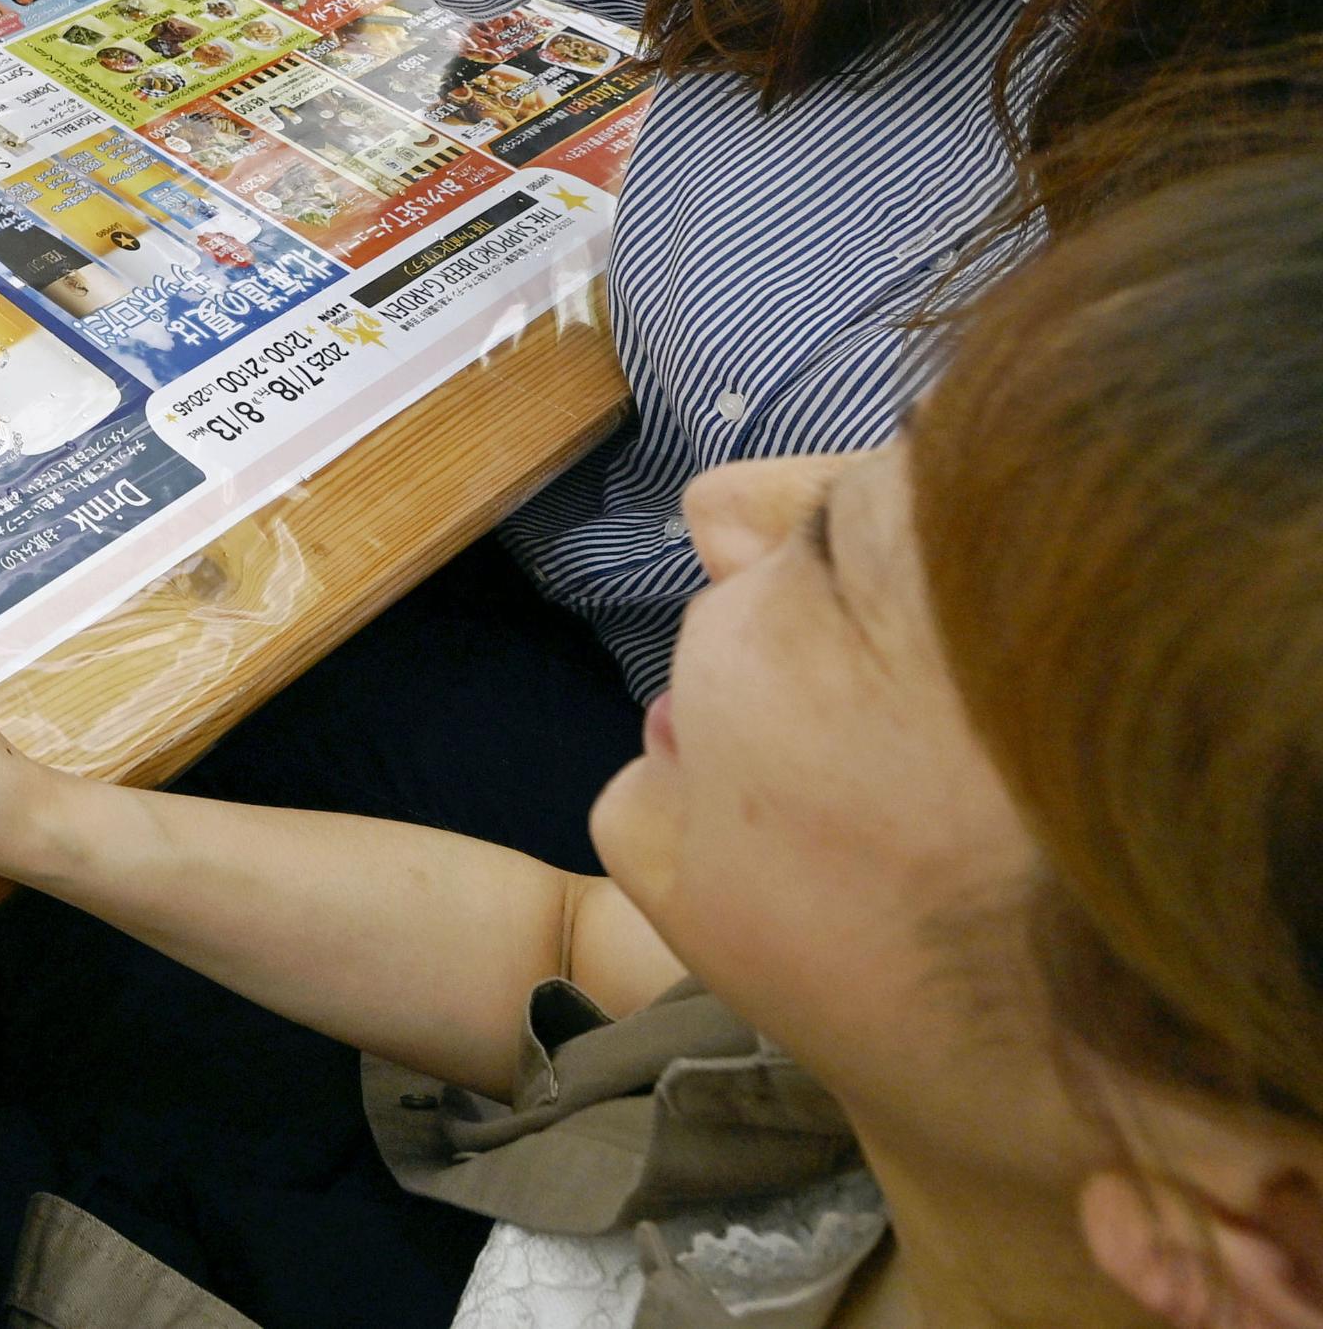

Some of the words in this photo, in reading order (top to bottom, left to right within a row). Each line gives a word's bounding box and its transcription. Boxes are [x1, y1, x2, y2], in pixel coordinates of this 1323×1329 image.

[468, 218, 495, 236] THE
[531, 205, 562, 229] THE
[468, 218, 534, 266] SAPPORO
[441, 258, 474, 285] BEER
[69, 263, 212, 349] サッポロだ！
[165, 248, 333, 346] 北海道の夏は
[316, 302, 347, 322] LION
[377, 277, 445, 323] GARDEN
[263, 330, 313, 363] 12:00
[302, 341, 349, 372] 2025.
[215, 356, 267, 393] 21:00
[266, 364, 324, 402] 7/18
[172, 389, 204, 417] 20:45
[206, 400, 265, 442] 8/13
[64, 477, 151, 535] Drink
